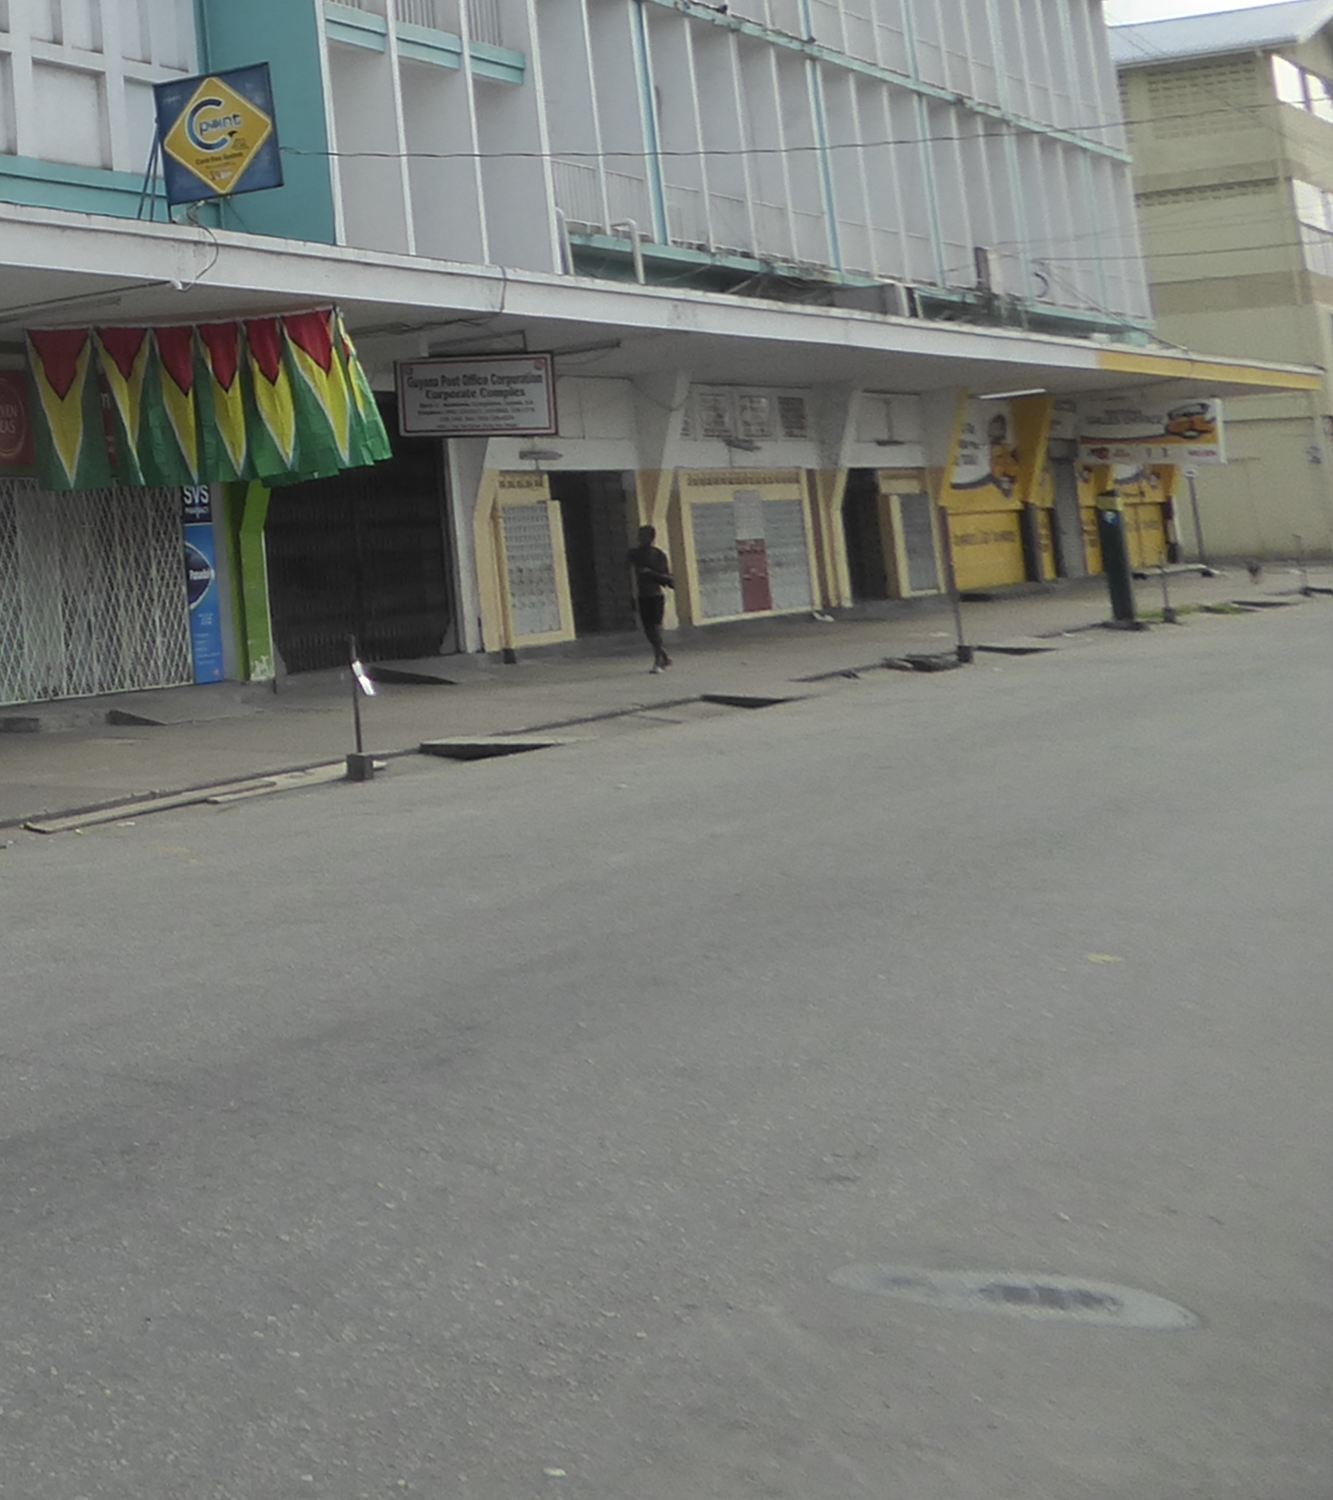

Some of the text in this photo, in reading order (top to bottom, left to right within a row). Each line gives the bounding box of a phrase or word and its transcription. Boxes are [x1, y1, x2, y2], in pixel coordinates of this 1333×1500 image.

[406, 372, 544, 390] Guyana Post Office Corporation
[425, 387, 526, 401] Corporate Complex
[183, 484, 209, 505] SVS
